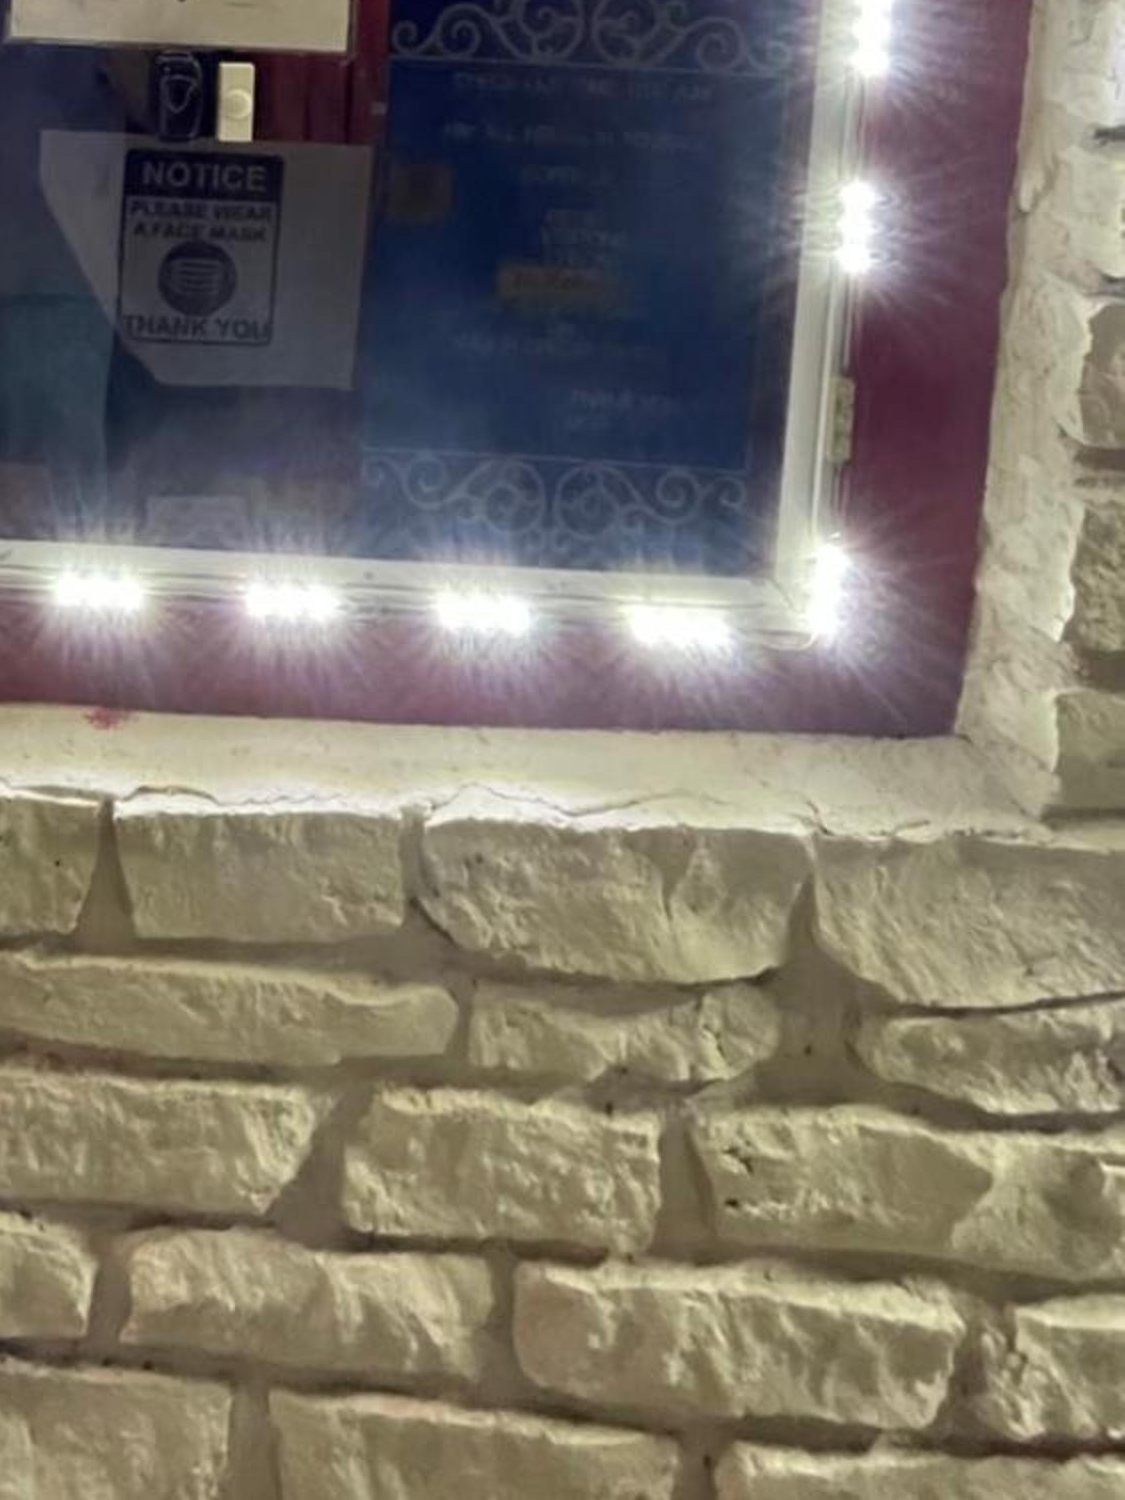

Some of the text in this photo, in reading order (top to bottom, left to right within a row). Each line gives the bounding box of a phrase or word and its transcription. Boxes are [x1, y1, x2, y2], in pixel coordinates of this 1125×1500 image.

[142, 160, 268, 193] NOTICE
[130, 201, 273, 222] PLEASE WEAR
[209, 225, 267, 241] MASK
[124, 314, 274, 341] THANK YOU
